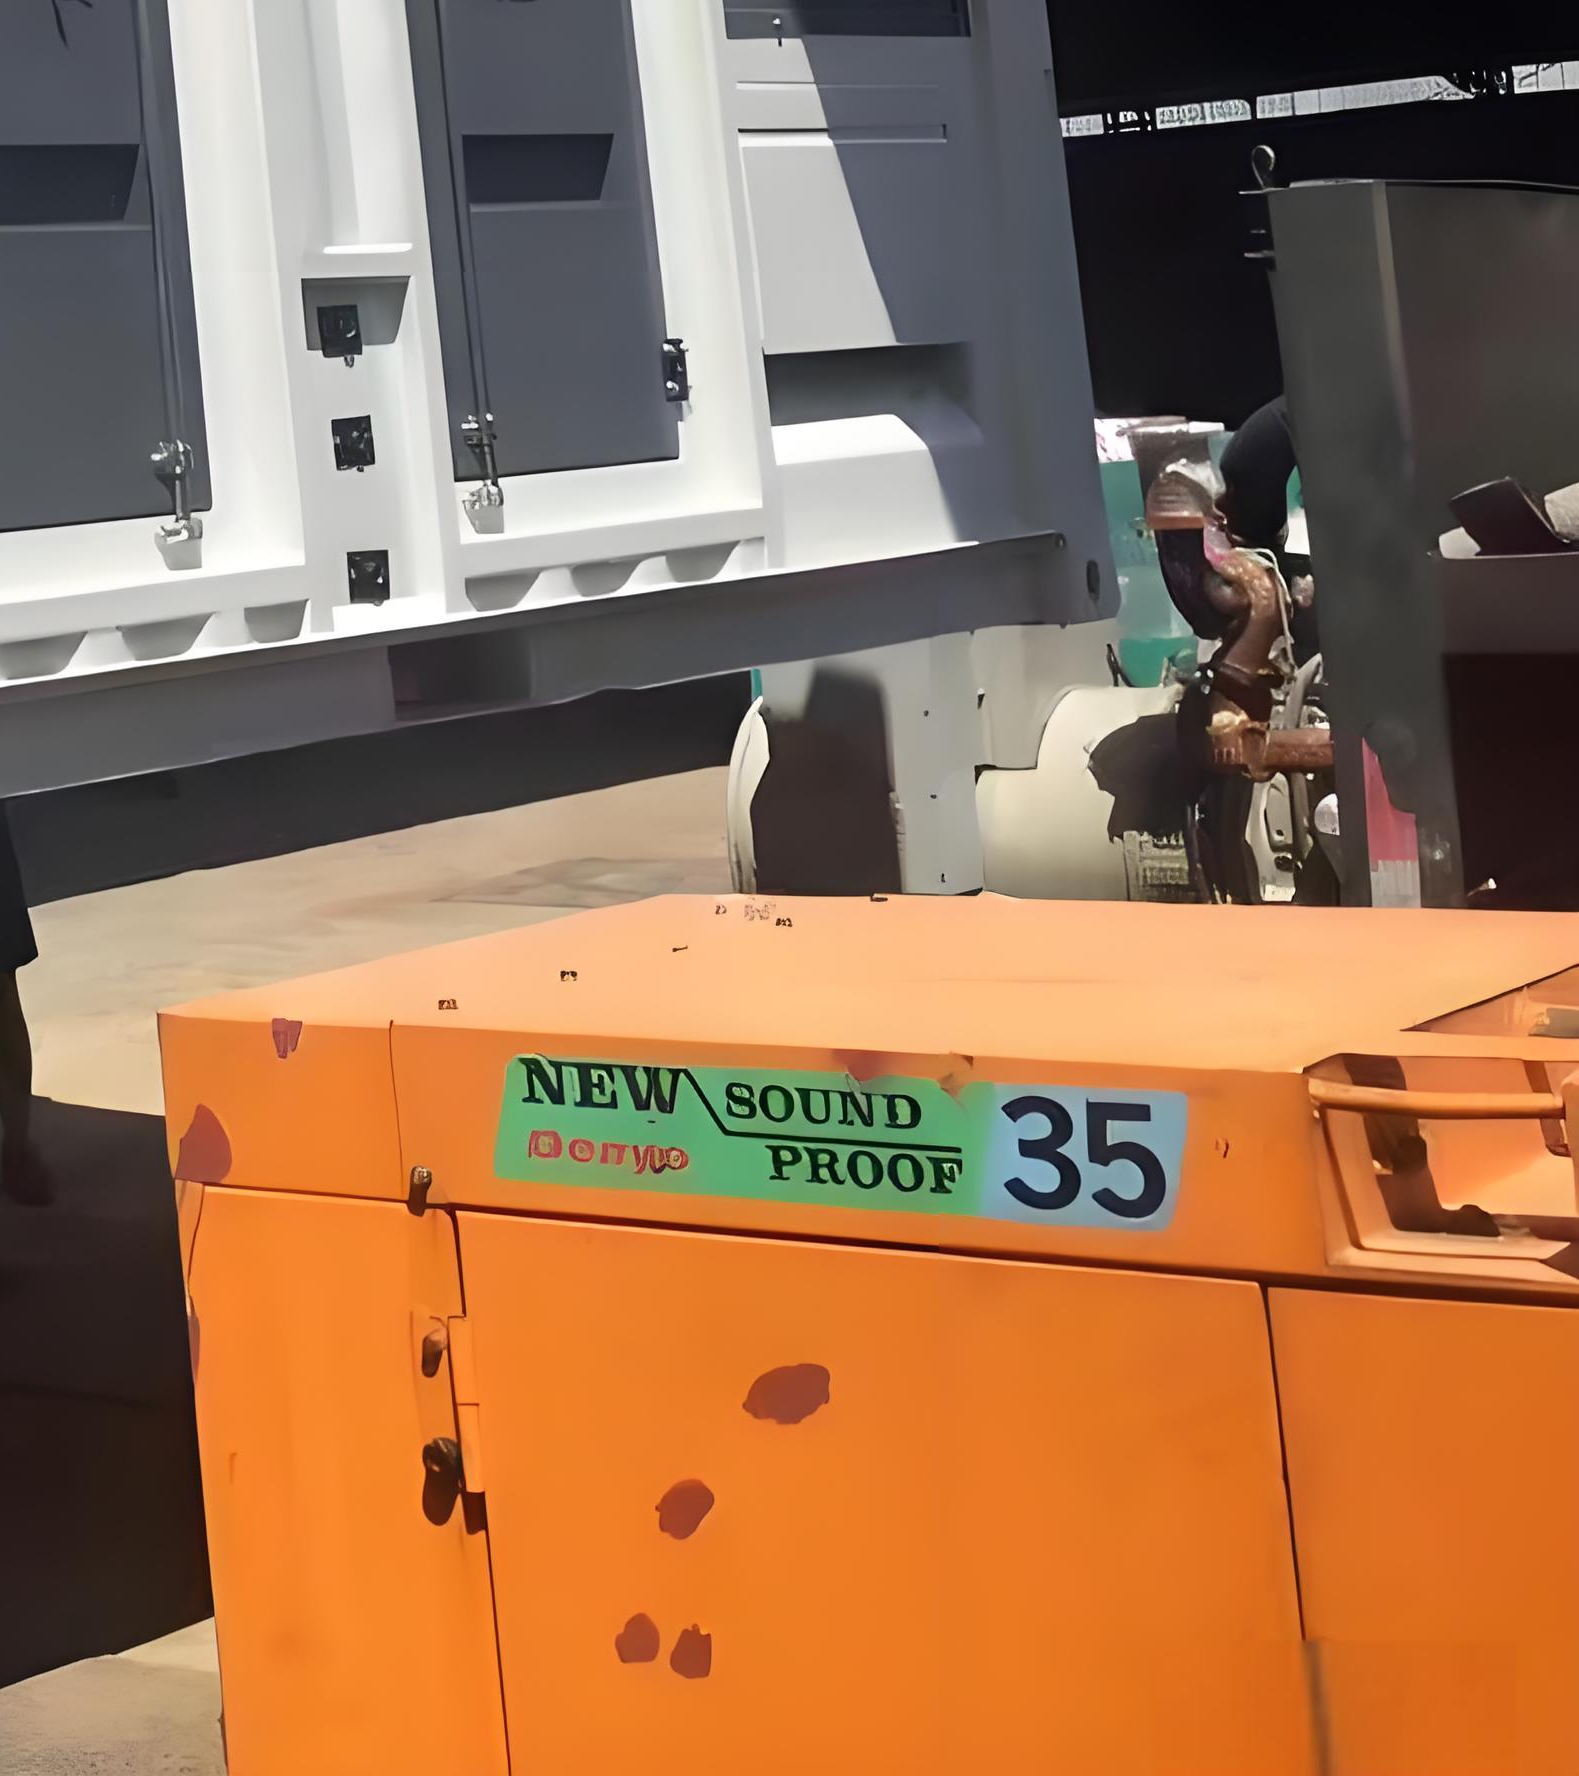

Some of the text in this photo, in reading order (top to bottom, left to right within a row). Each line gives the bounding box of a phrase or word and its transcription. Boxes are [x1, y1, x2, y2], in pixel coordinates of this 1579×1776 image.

[517, 1057, 683, 1114] NEW
[725, 1082, 922, 1129] SOUND
[764, 1144, 963, 1194] PROOF
[1001, 1095, 1167, 1219] 35
